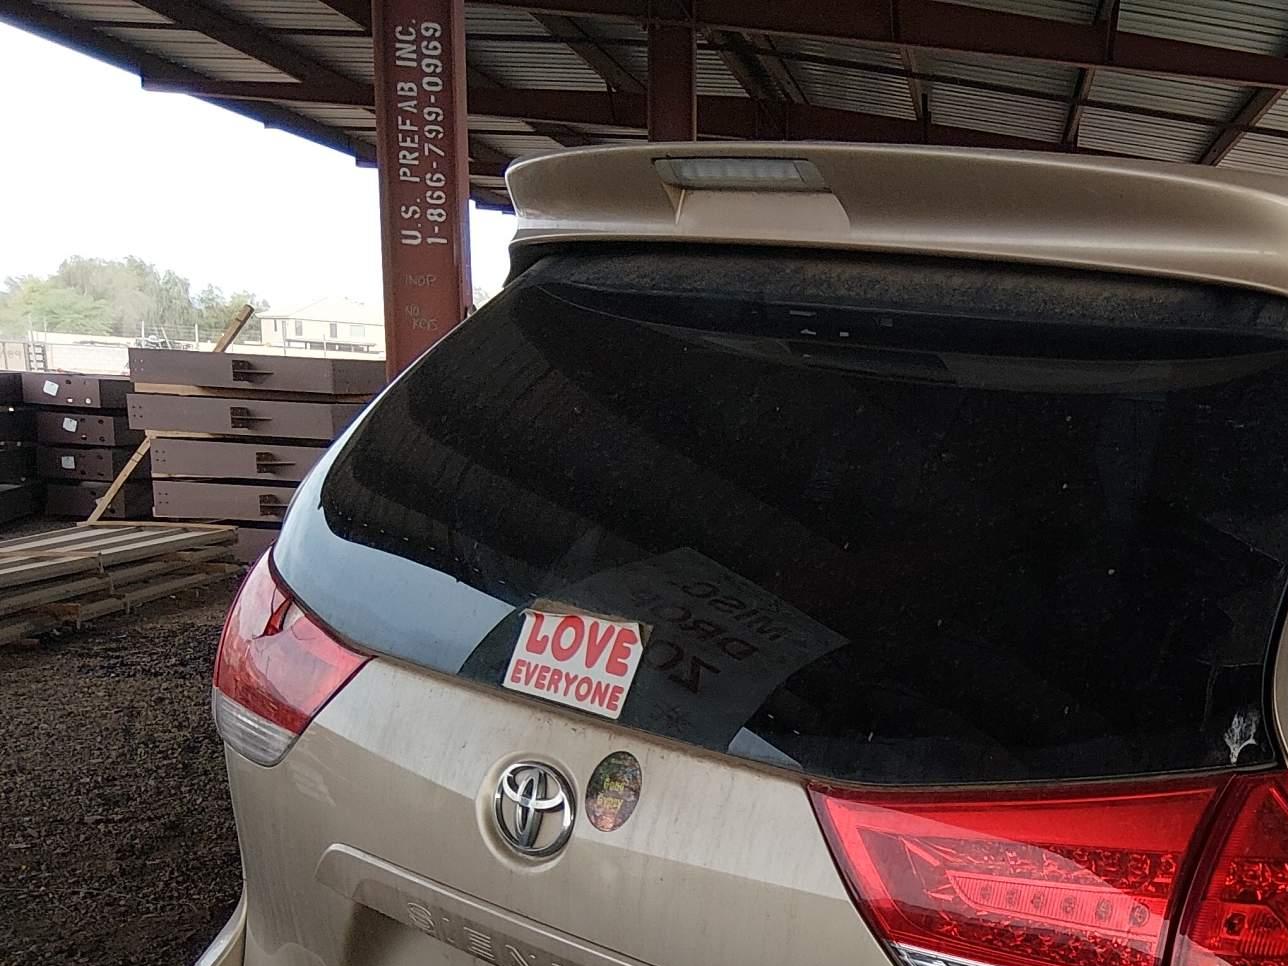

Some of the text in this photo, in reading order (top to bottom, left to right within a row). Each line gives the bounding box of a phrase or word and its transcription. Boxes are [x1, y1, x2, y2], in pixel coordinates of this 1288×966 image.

[394, 18, 423, 246] U.S. PREFAB INC.
[420, 21, 449, 246] 1-866-799-0969
[510, 658, 625, 713] EVERYONE
[525, 613, 641, 677] LOVE
